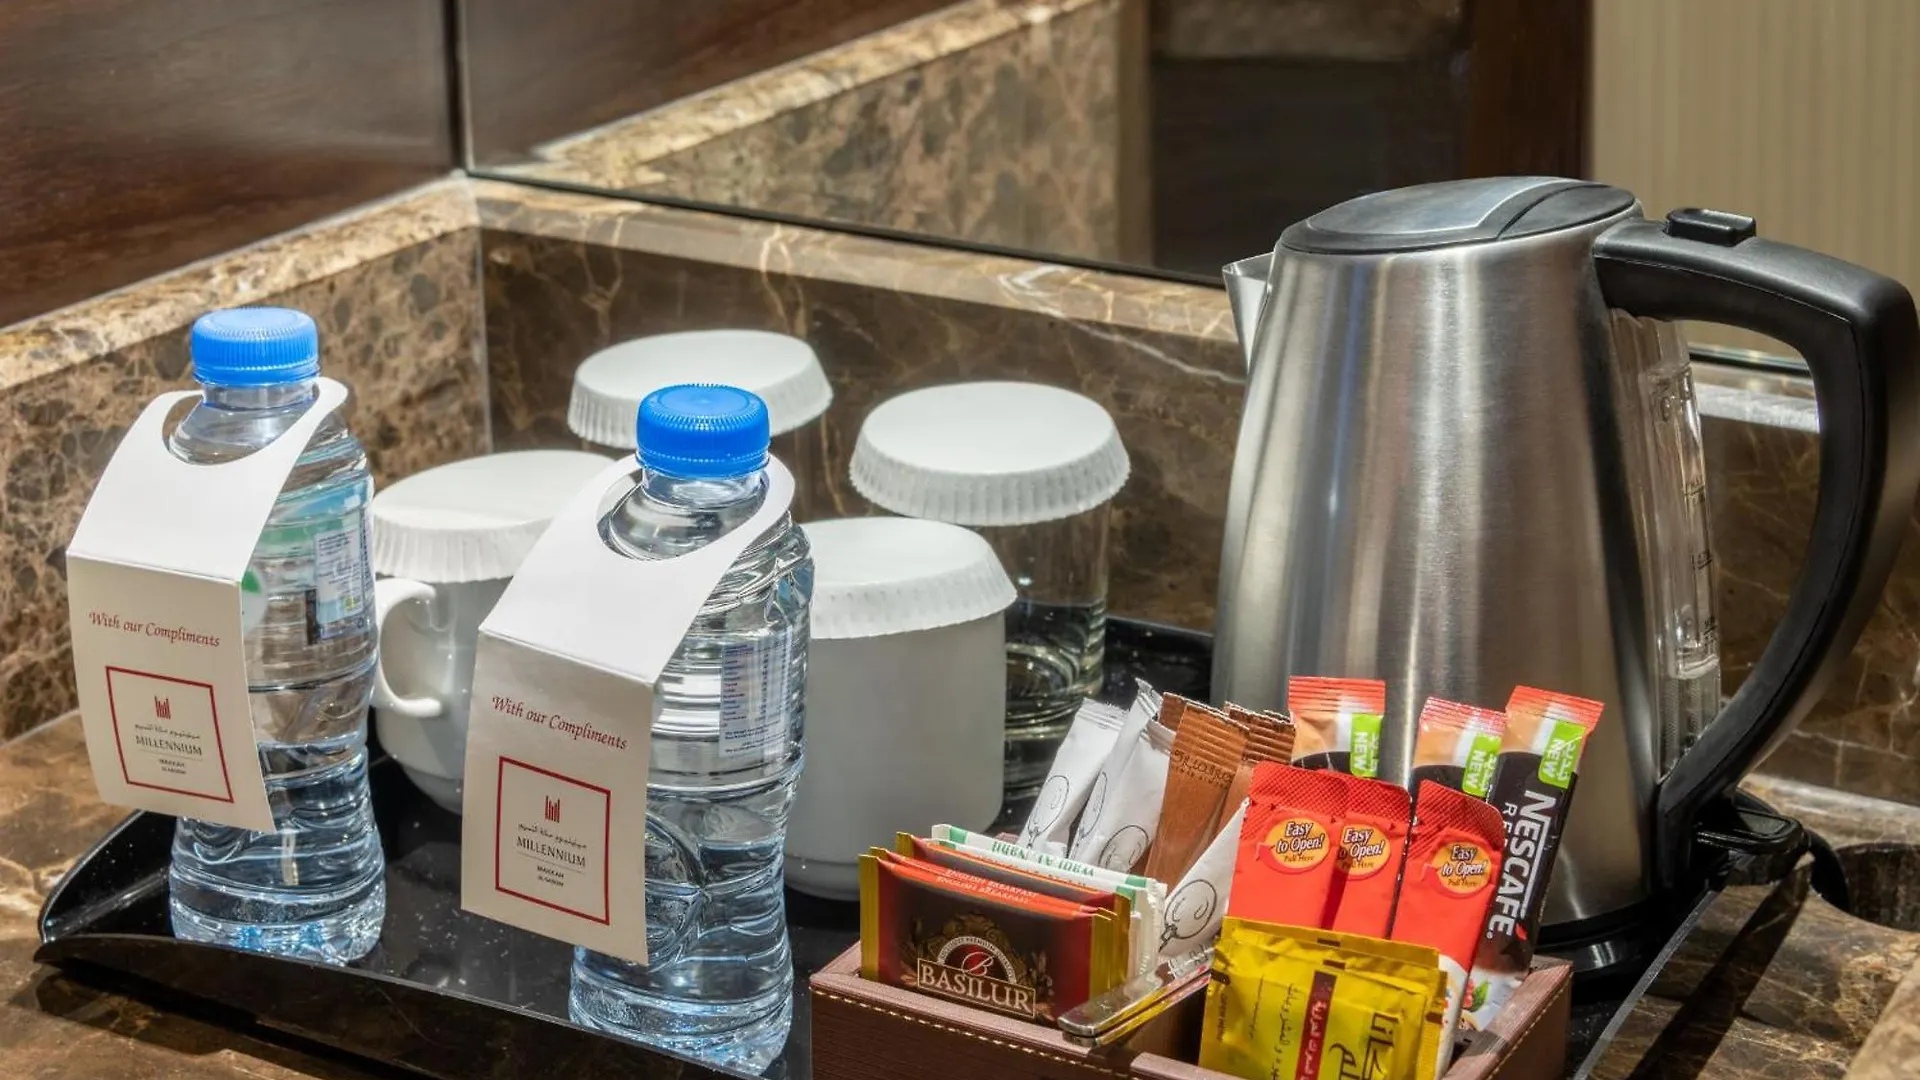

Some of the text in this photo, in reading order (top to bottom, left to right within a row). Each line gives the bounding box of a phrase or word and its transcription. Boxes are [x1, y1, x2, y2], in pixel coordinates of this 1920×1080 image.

[89, 611, 220, 648] With our Compliments
[492, 695, 628, 750] With our Compliments
[135, 735, 203, 757] MILLENNIUM
[1354, 732, 1368, 769] NEW
[1543, 739, 1565, 778] NEW
[1467, 750, 1486, 789] NEW
[1285, 821, 1314, 837] Easy
[1343, 828, 1373, 845] Easy
[517, 835, 586, 868] MILLENNIUM
[1275, 833, 1325, 855] to Open!
[1350, 840, 1385, 860] Open!
[1451, 845, 1478, 862] Easy
[1441, 860, 1488, 878] to Open!
[921, 963, 1032, 1014] BASILUR
